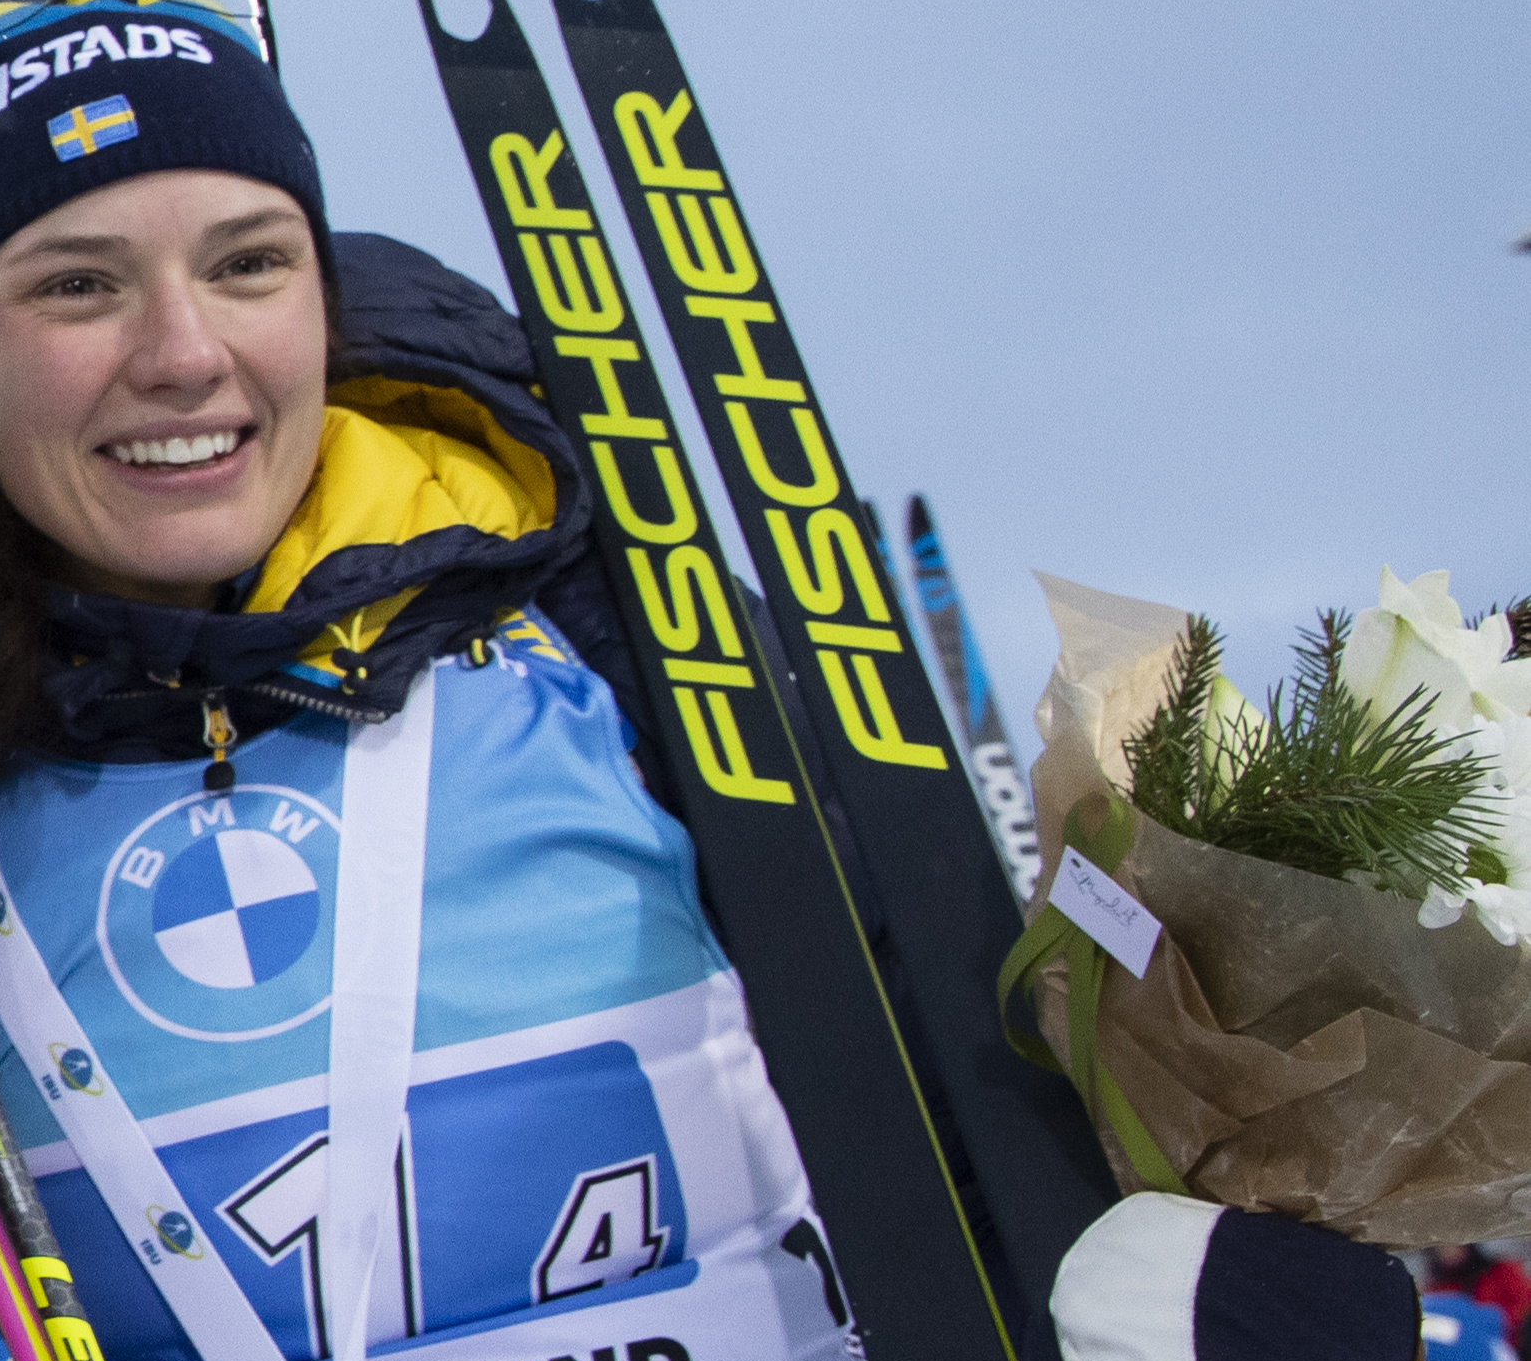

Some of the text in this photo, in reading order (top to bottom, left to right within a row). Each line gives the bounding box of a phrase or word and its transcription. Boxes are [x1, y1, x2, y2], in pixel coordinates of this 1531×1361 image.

[488, 128, 795, 805] FISCHER
[614, 89, 948, 770] FISCHER
[121, 798, 319, 889] BMW
[529, 1152, 671, 1309] 4
